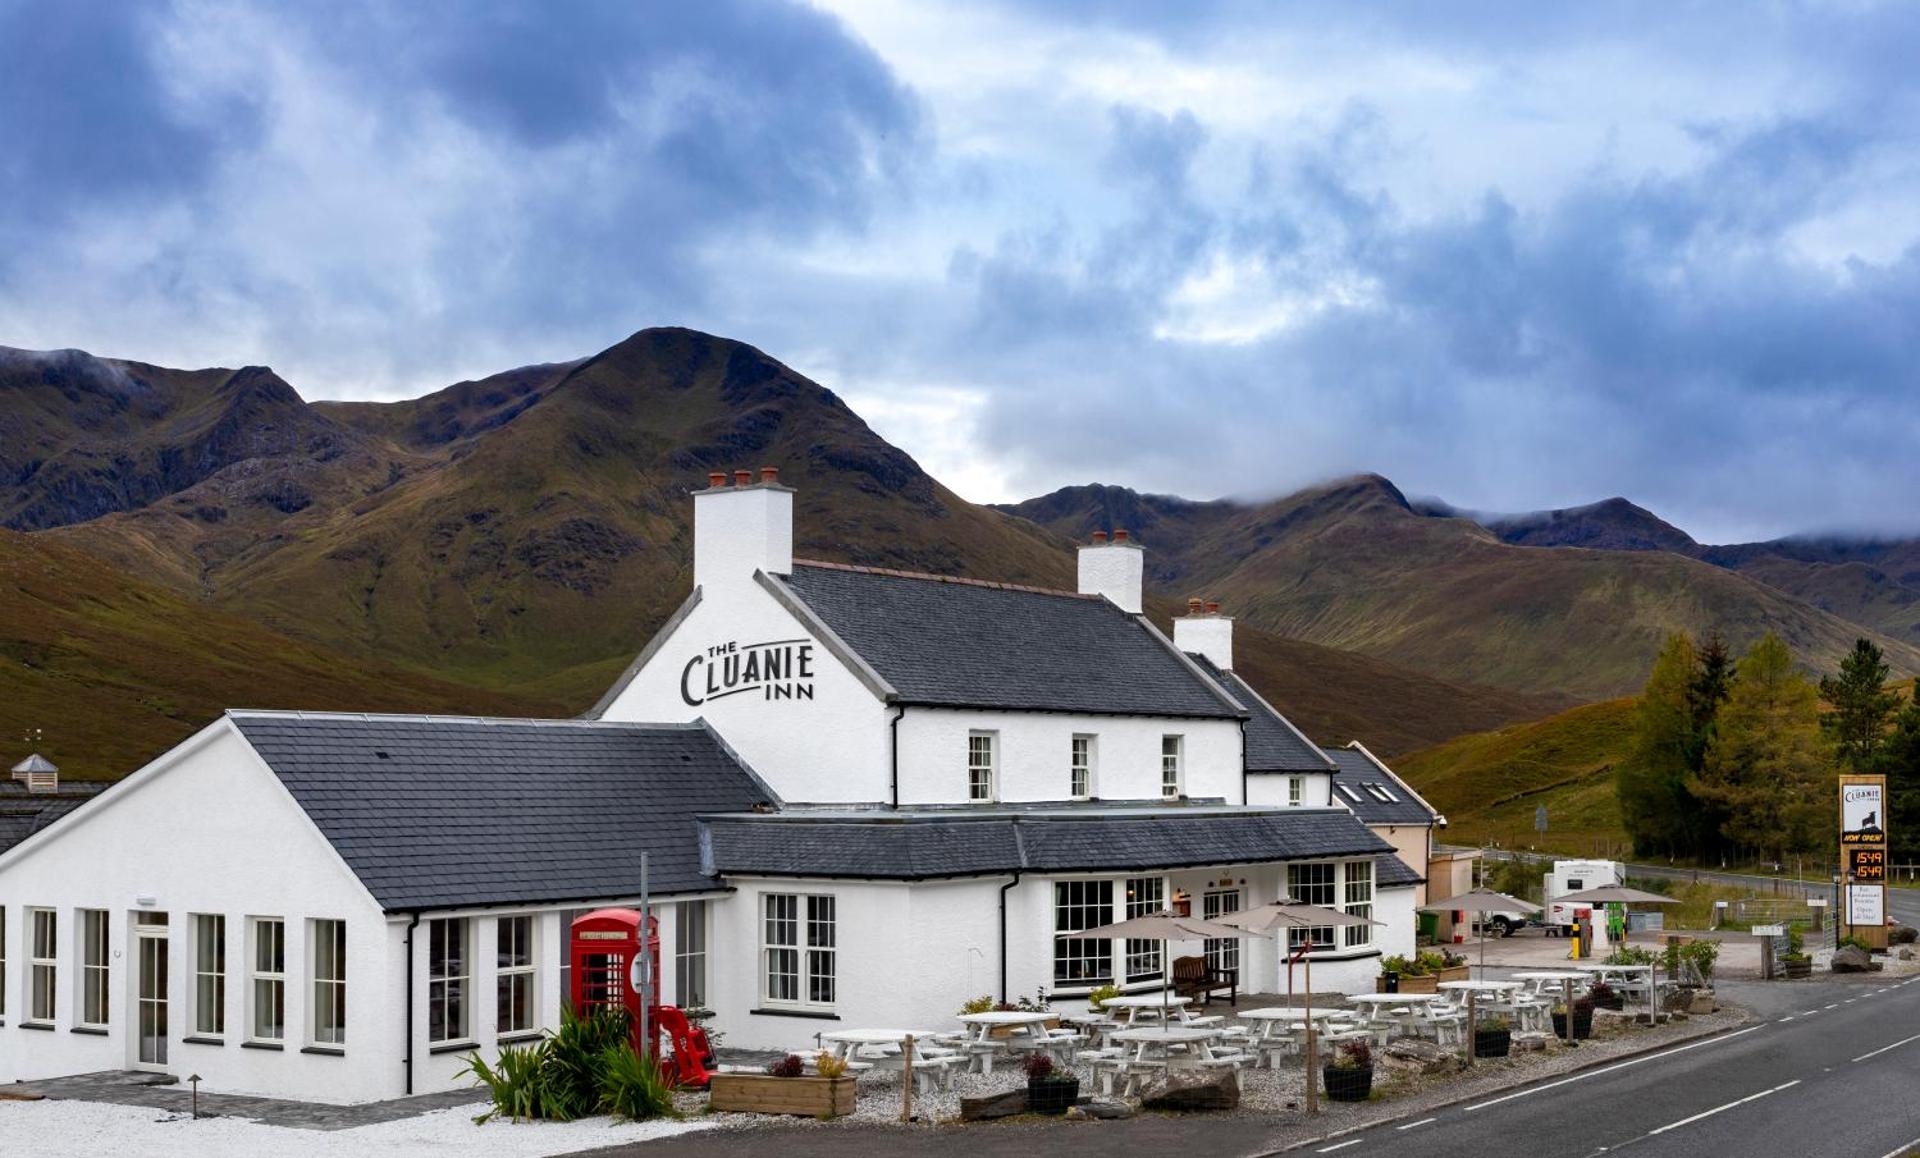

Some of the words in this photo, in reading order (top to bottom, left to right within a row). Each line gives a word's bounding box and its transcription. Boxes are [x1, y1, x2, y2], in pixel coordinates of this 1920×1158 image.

[708, 641, 737, 657] THE
[681, 645, 814, 706] CLUANIE
[766, 683, 813, 700] INN
[1845, 790, 1879, 803] CLUANIE
